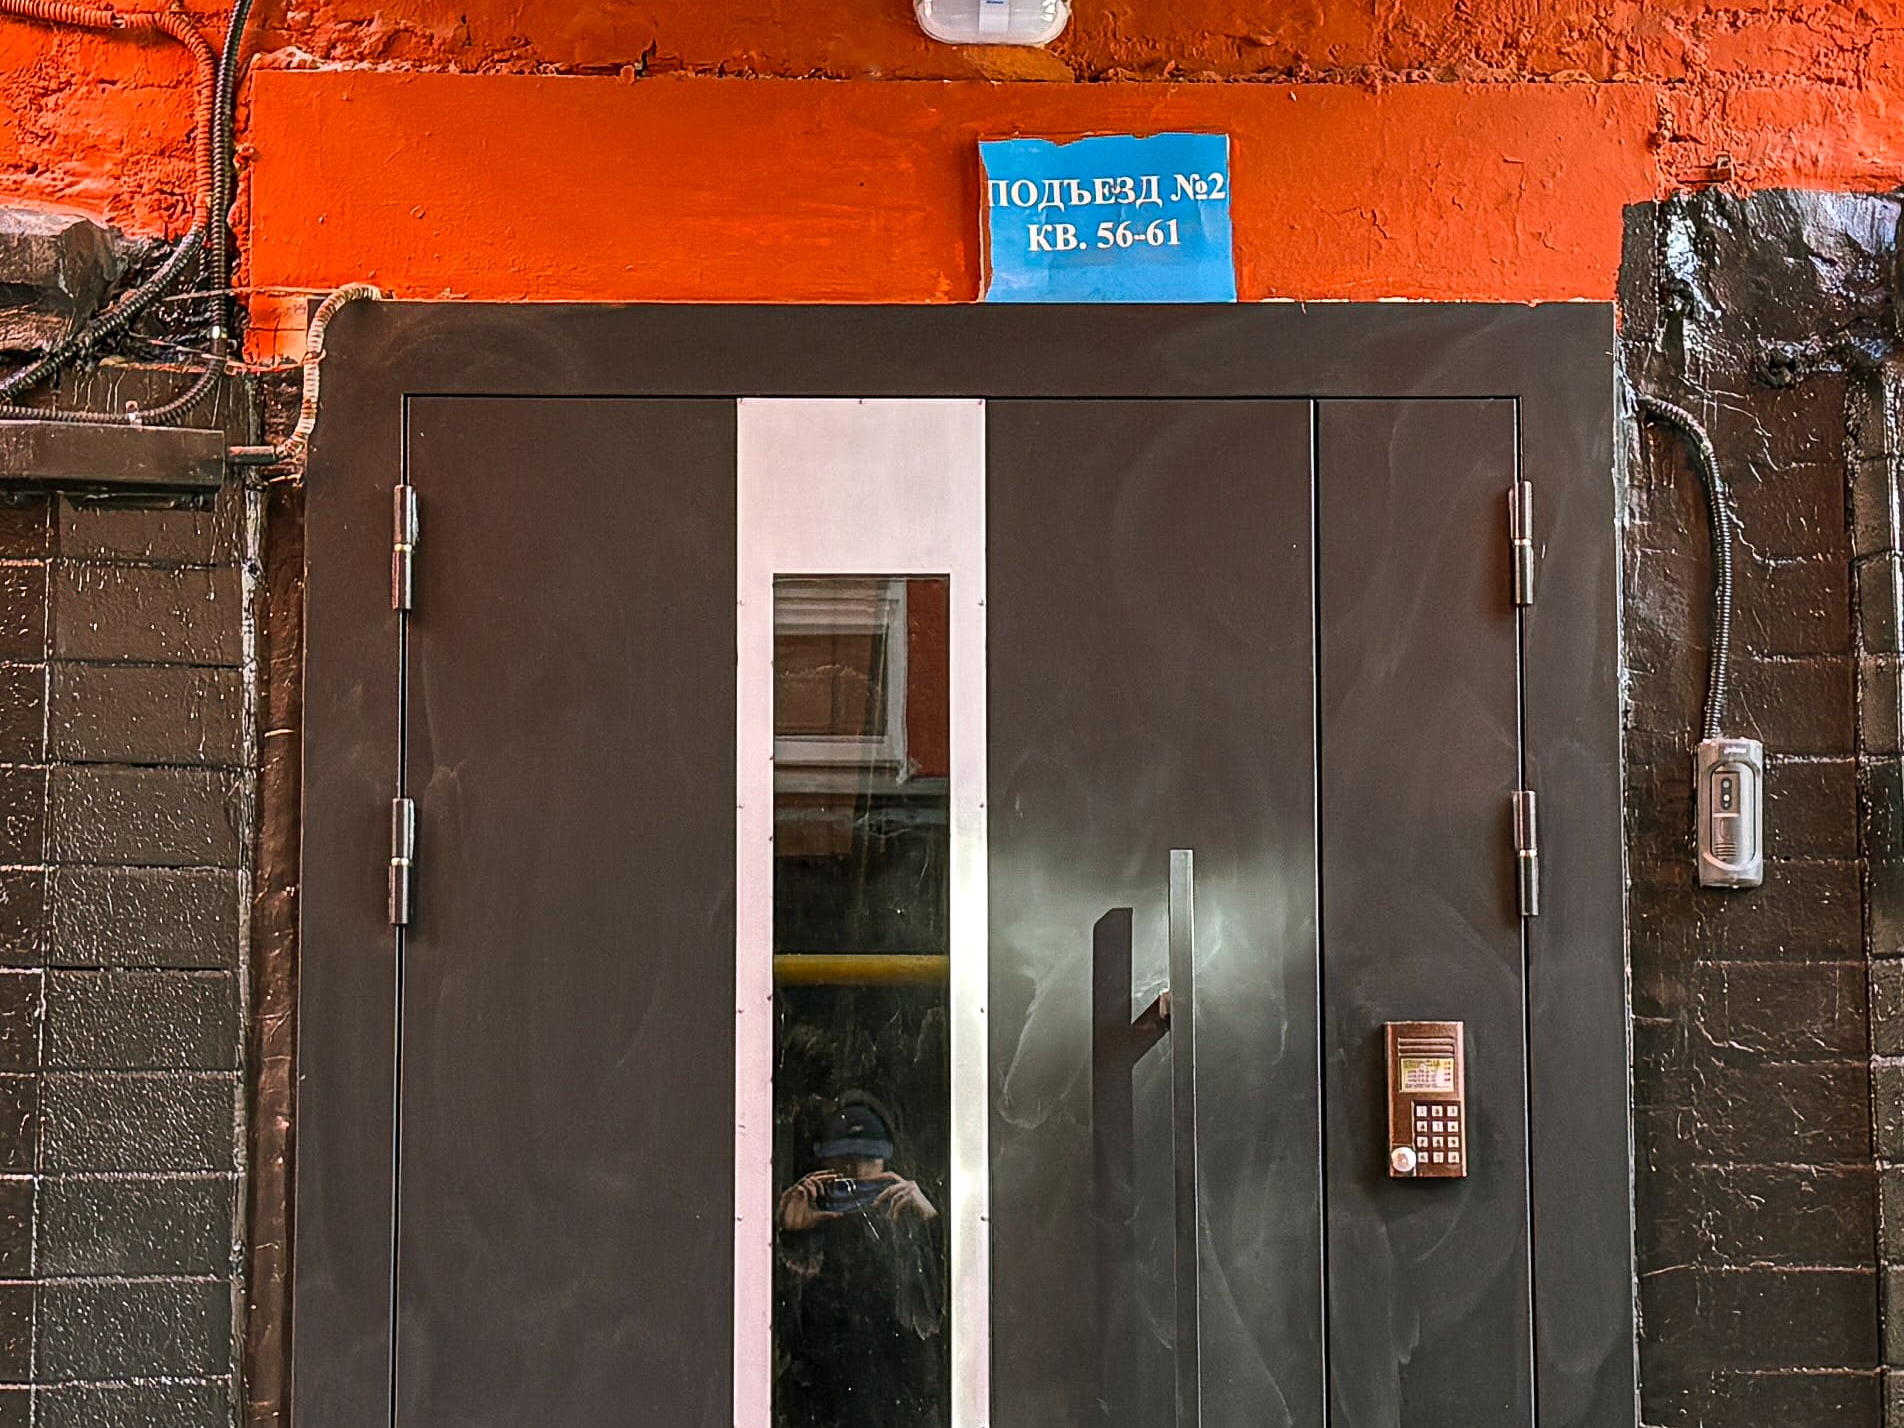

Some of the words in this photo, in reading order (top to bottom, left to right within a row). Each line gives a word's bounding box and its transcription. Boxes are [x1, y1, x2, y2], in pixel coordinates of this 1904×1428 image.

[988, 175, 1162, 212] ПОДЪЕЗД
[1170, 172, 1226, 202] №2
[1027, 223, 1087, 252] КВ.
[1097, 219, 1181, 249] 56-61
